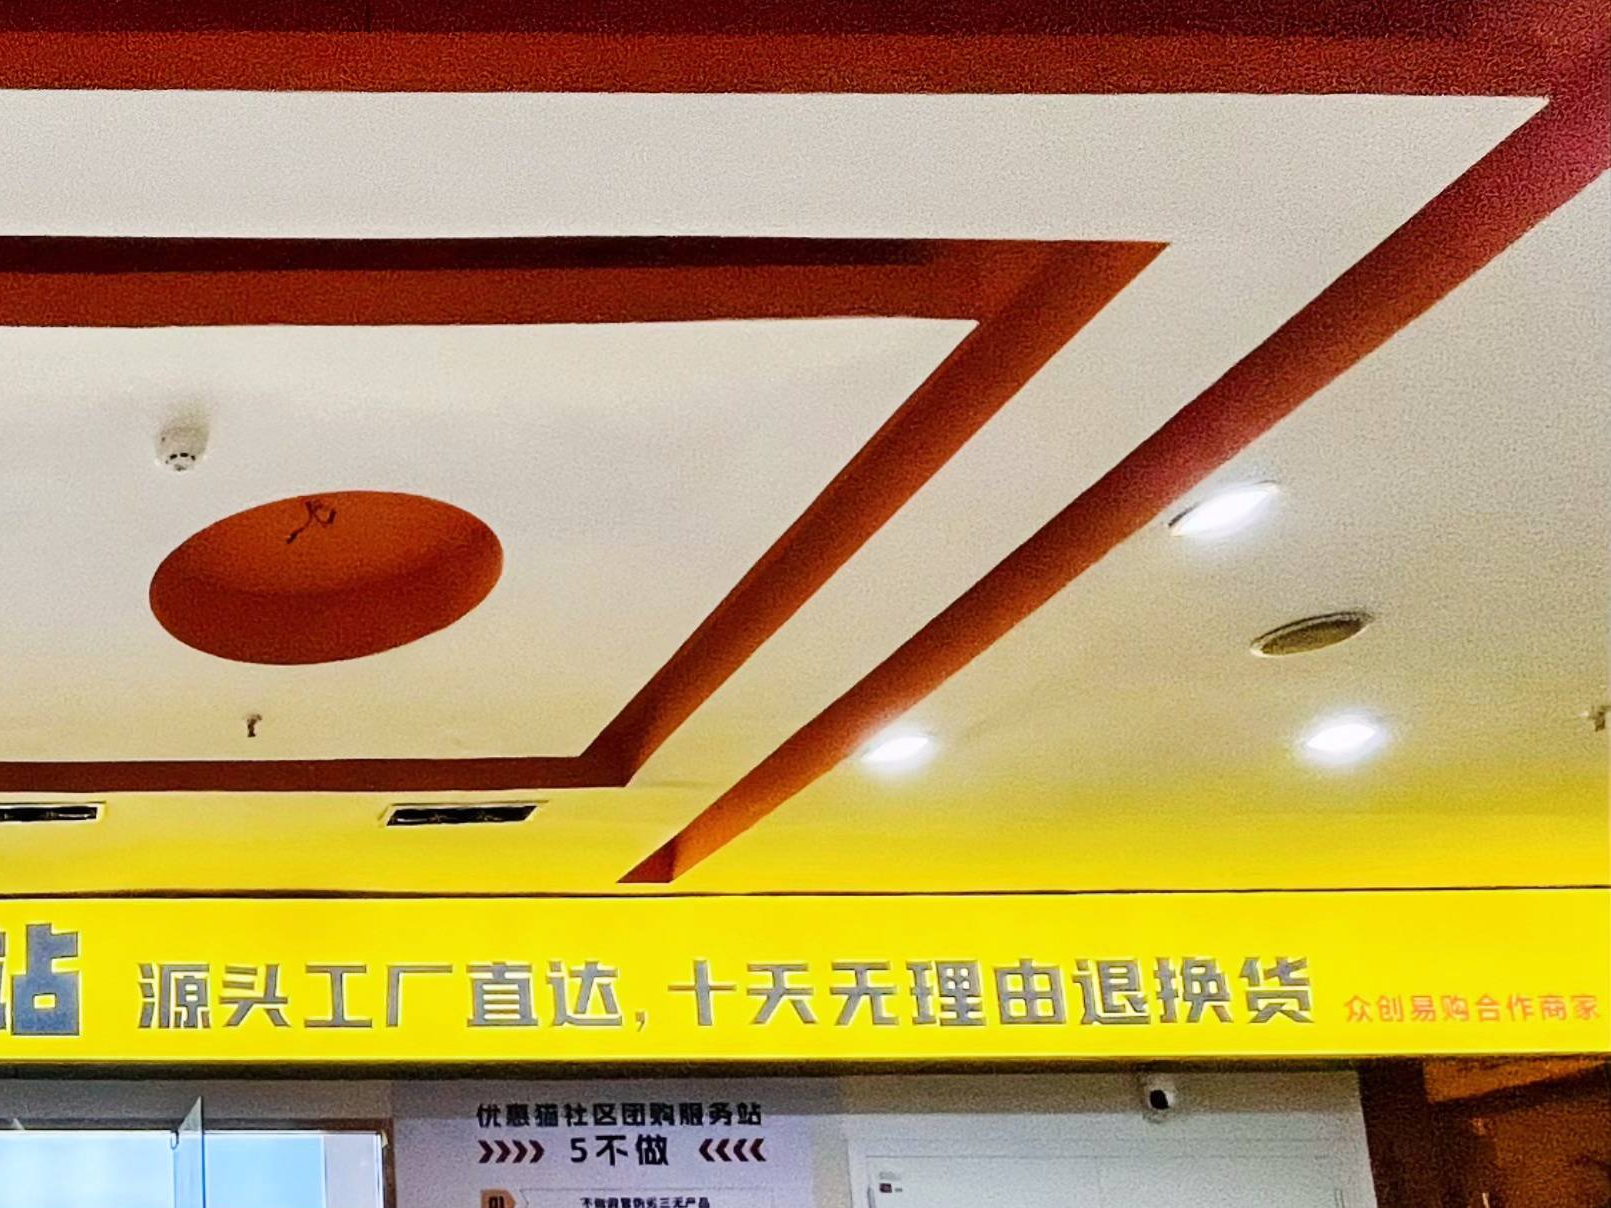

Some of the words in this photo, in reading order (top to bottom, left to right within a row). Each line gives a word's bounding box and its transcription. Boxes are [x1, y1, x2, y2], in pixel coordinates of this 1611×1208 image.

[1344, 992, 1603, 1026] 众创易购合作商家
[476, 1102, 763, 1128] 优惠猫社区团购服务站
[570, 1134, 669, 1166] 5不做
